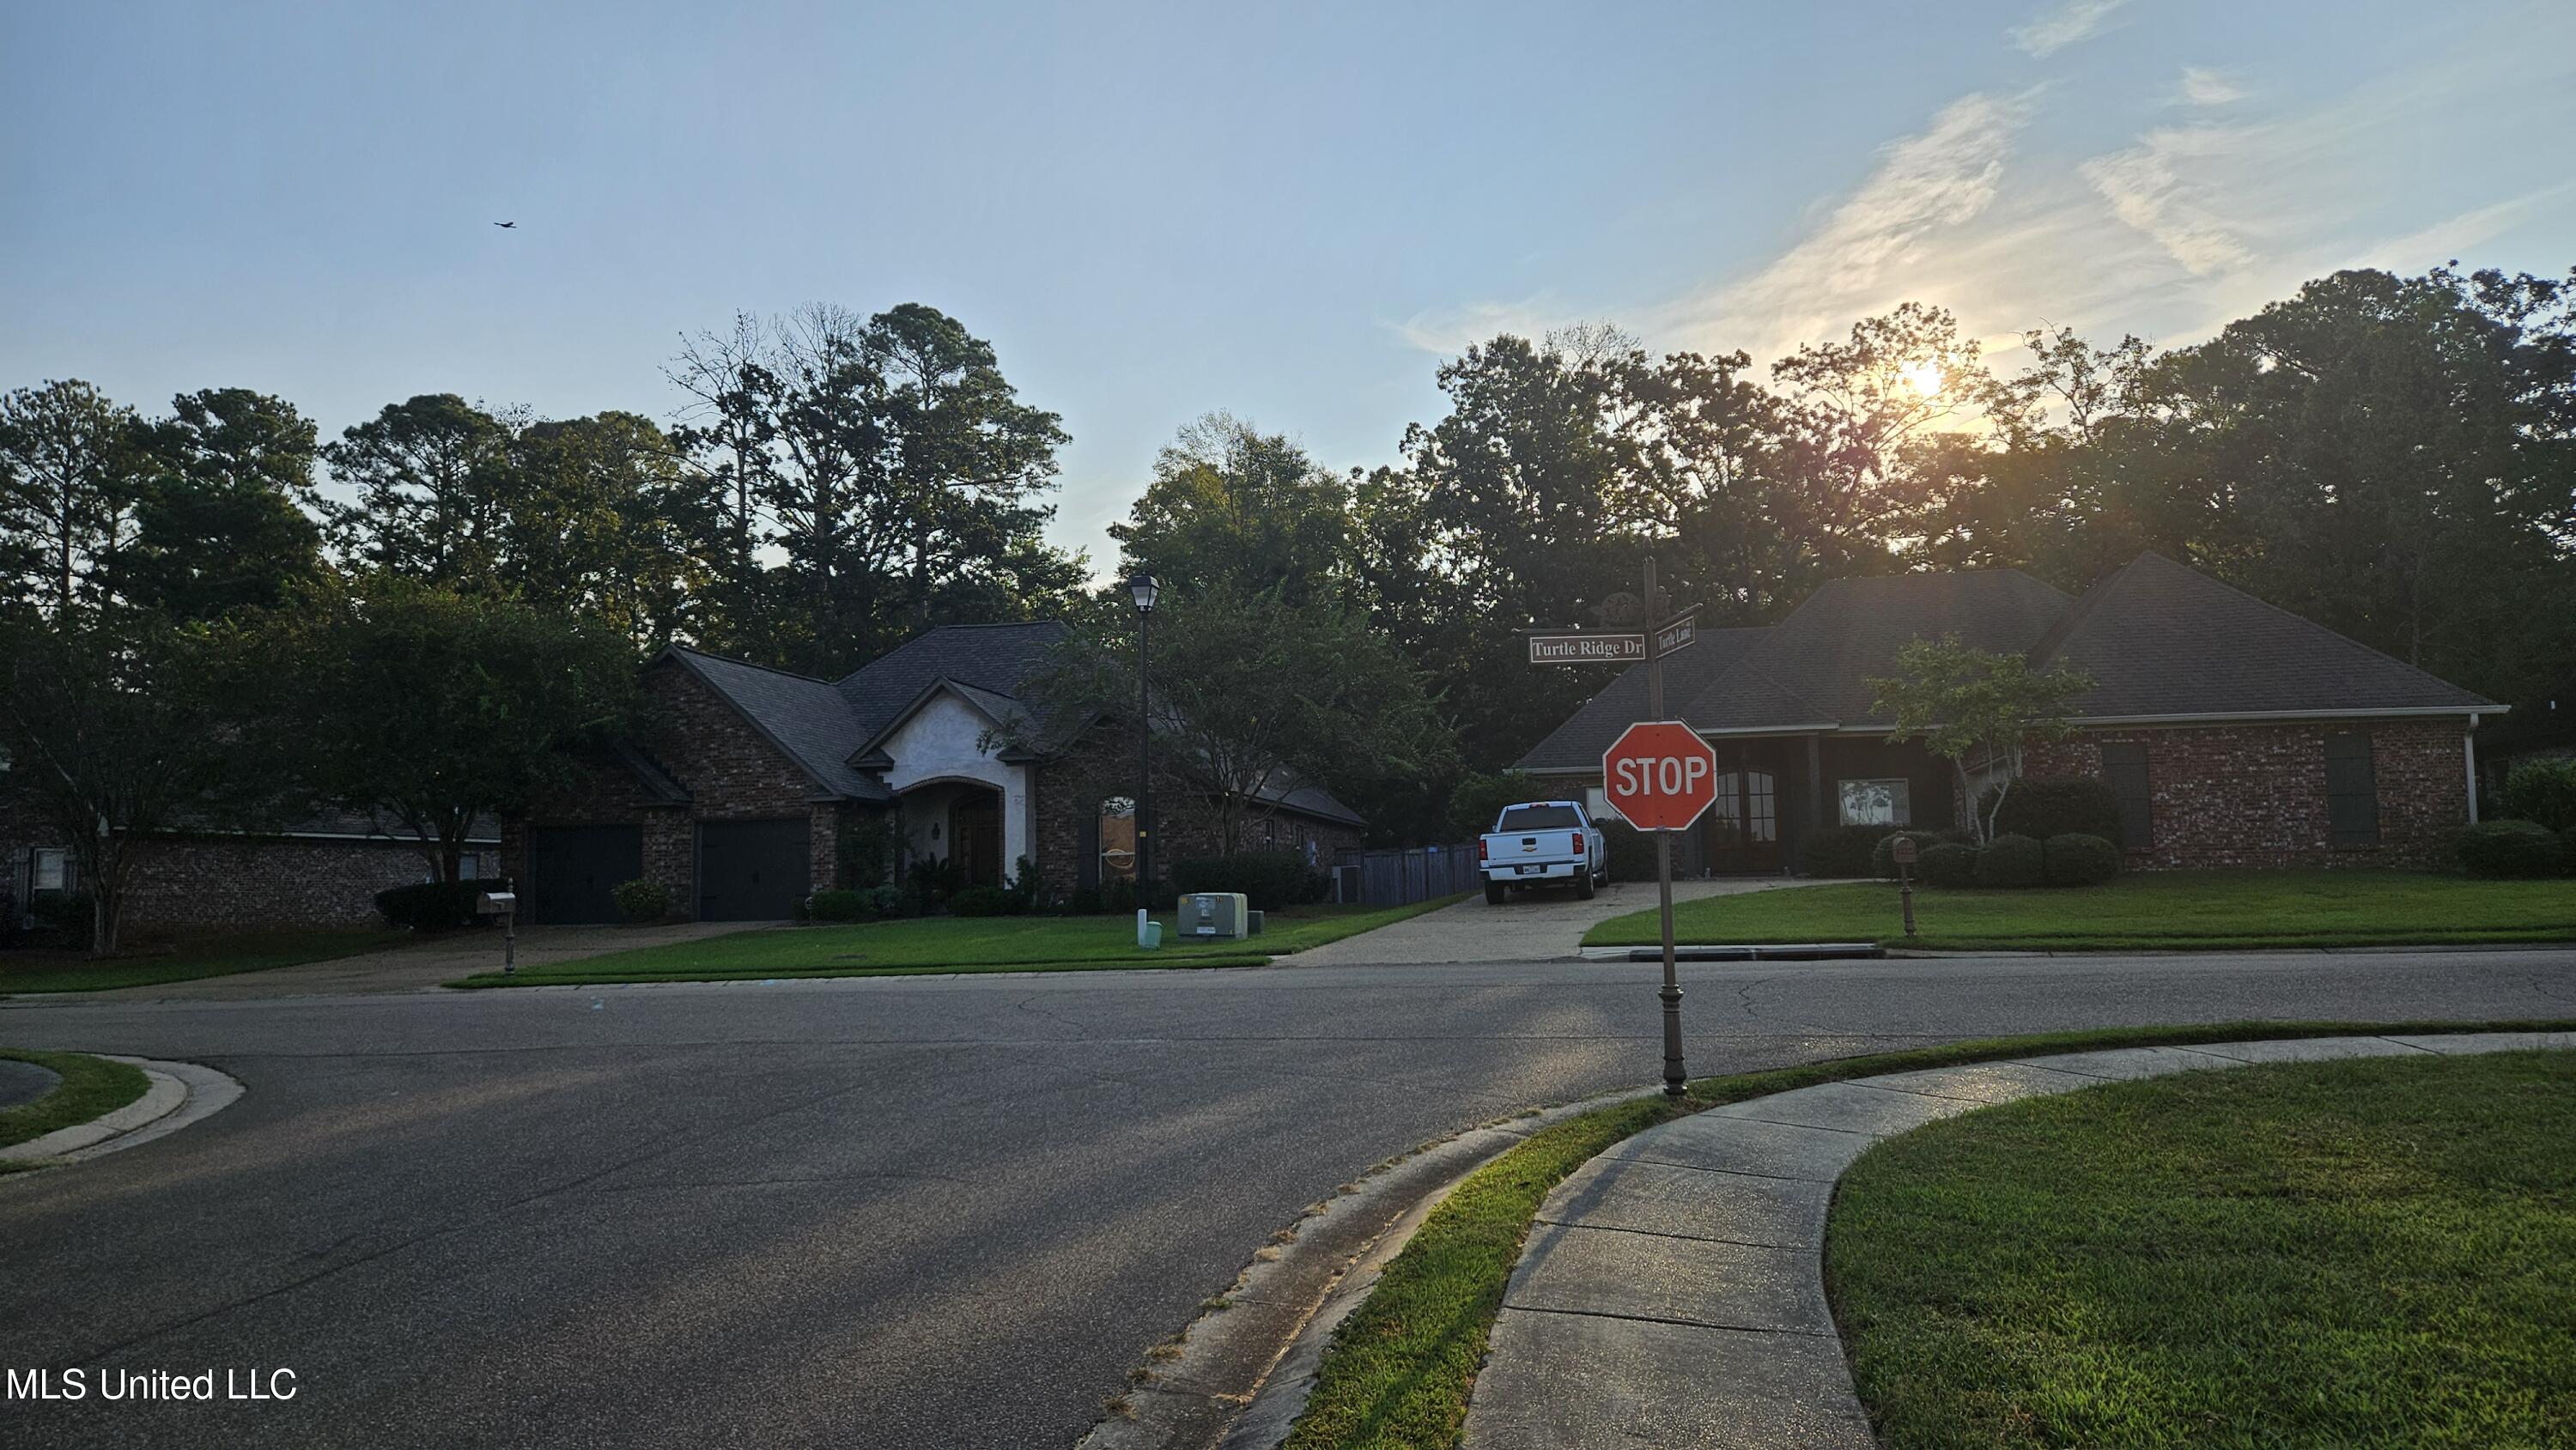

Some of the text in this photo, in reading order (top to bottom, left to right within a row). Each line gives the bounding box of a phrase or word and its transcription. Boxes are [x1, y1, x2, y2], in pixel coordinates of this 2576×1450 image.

[1532, 640, 1643, 658] Turtle Ridge Dr
[1657, 631, 1676, 650] Turtle
[1616, 756, 1708, 797] STOP
